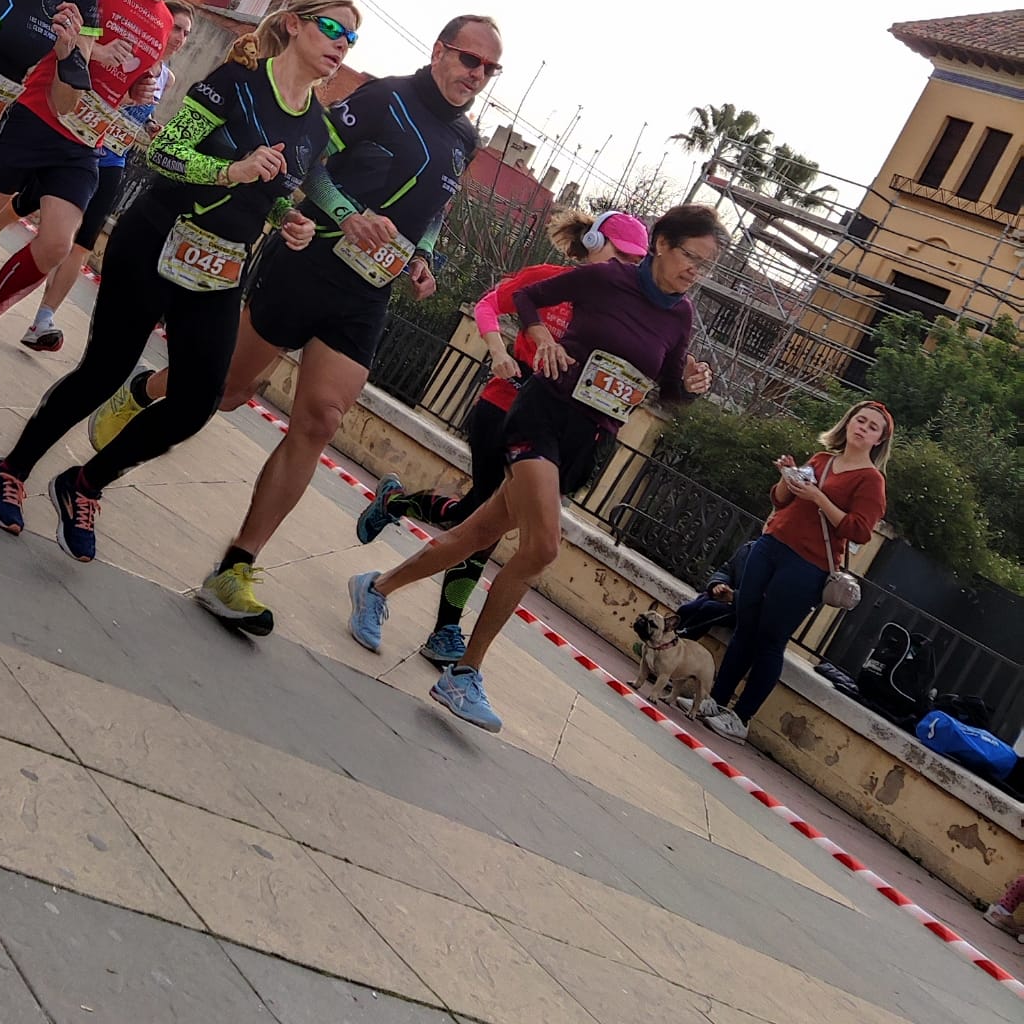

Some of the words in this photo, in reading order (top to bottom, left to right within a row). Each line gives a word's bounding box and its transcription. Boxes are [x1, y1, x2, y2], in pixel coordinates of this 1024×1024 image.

[77, 106, 100, 128] 185
[109, 123, 127, 141] 134
[184, 247, 226, 275] 045
[603, 376, 633, 403] 132
